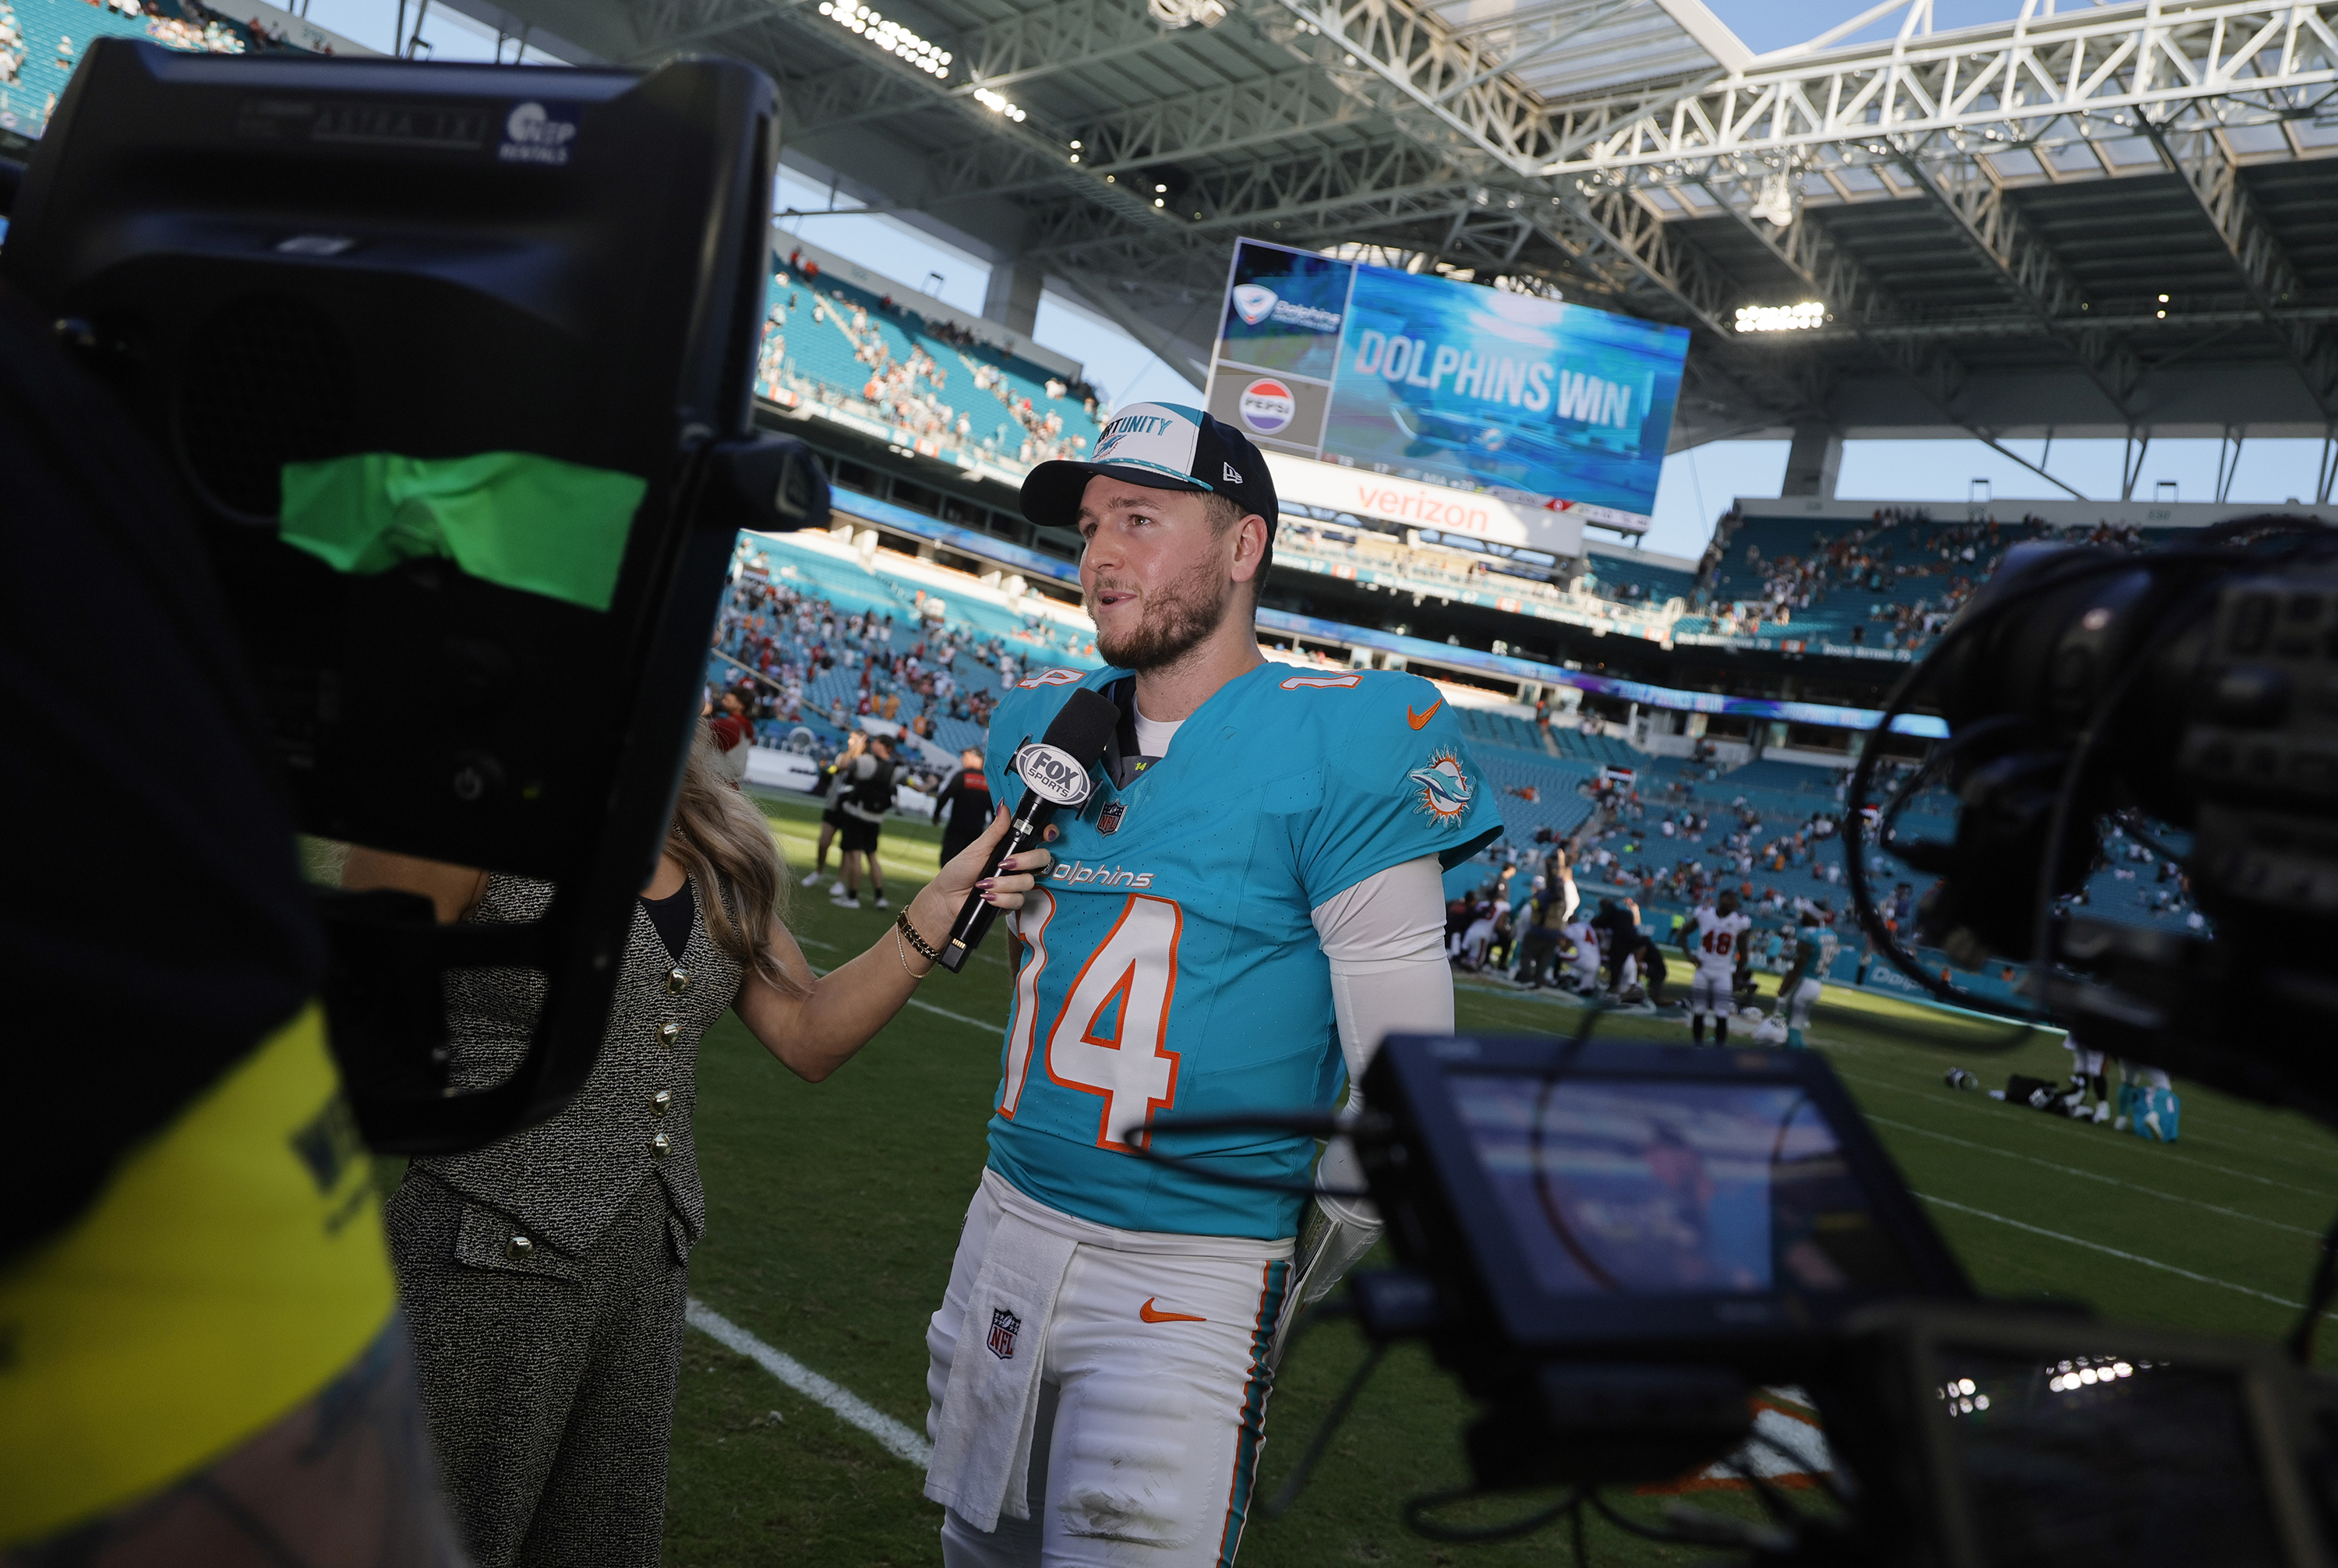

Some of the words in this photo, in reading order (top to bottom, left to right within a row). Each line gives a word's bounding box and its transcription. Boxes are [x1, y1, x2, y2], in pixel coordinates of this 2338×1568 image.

[1354, 329, 1553, 411] DOLPHINS
[1556, 369, 1632, 429] WIN
[1358, 483, 1489, 532] verizon
[1032, 750, 1079, 790] FOX
[1135, 761, 1148, 771] 14
[1027, 768, 1070, 797] SPORTS
[1099, 814, 1118, 830] NFL
[1702, 929, 1732, 955] 48
[996, 884, 1184, 1154] 14
[990, 1326, 1014, 1356] NFL
